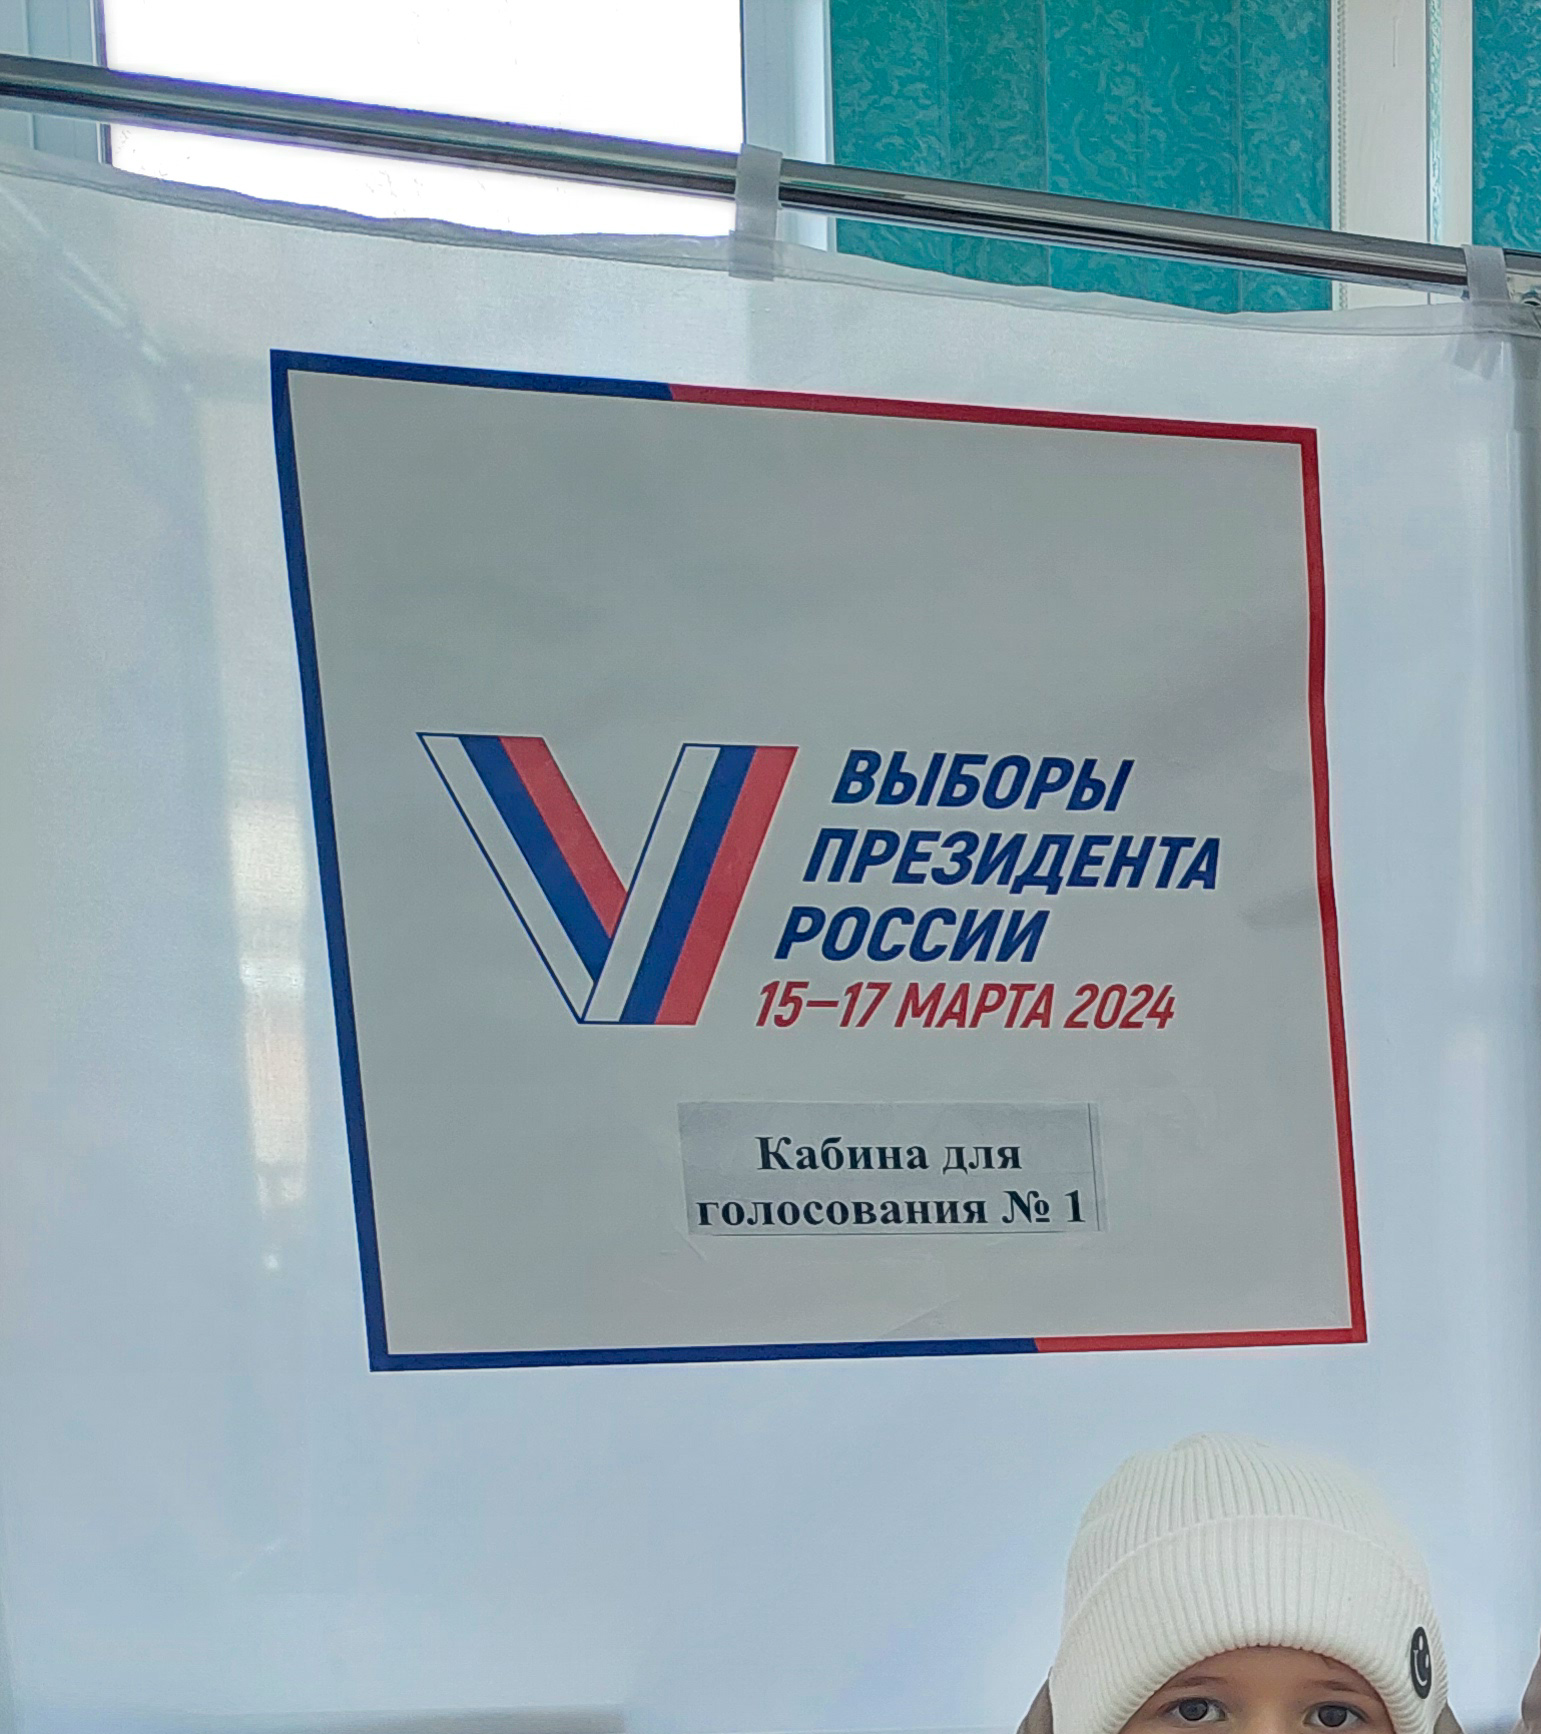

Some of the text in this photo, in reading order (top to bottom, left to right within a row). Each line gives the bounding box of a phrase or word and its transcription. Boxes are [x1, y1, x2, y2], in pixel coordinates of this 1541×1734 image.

[831, 749, 1135, 812] ВЫБОРЫ
[803, 828, 1221, 896] ПРЕЗИДЕНТА
[774, 906, 1050, 963] РОССИИ
[894, 983, 1054, 1031] МАРТА
[1063, 984, 1175, 1030] 2024
[755, 1136, 1022, 1175] Кабина для
[696, 1189, 1086, 1227] голосования № 1
